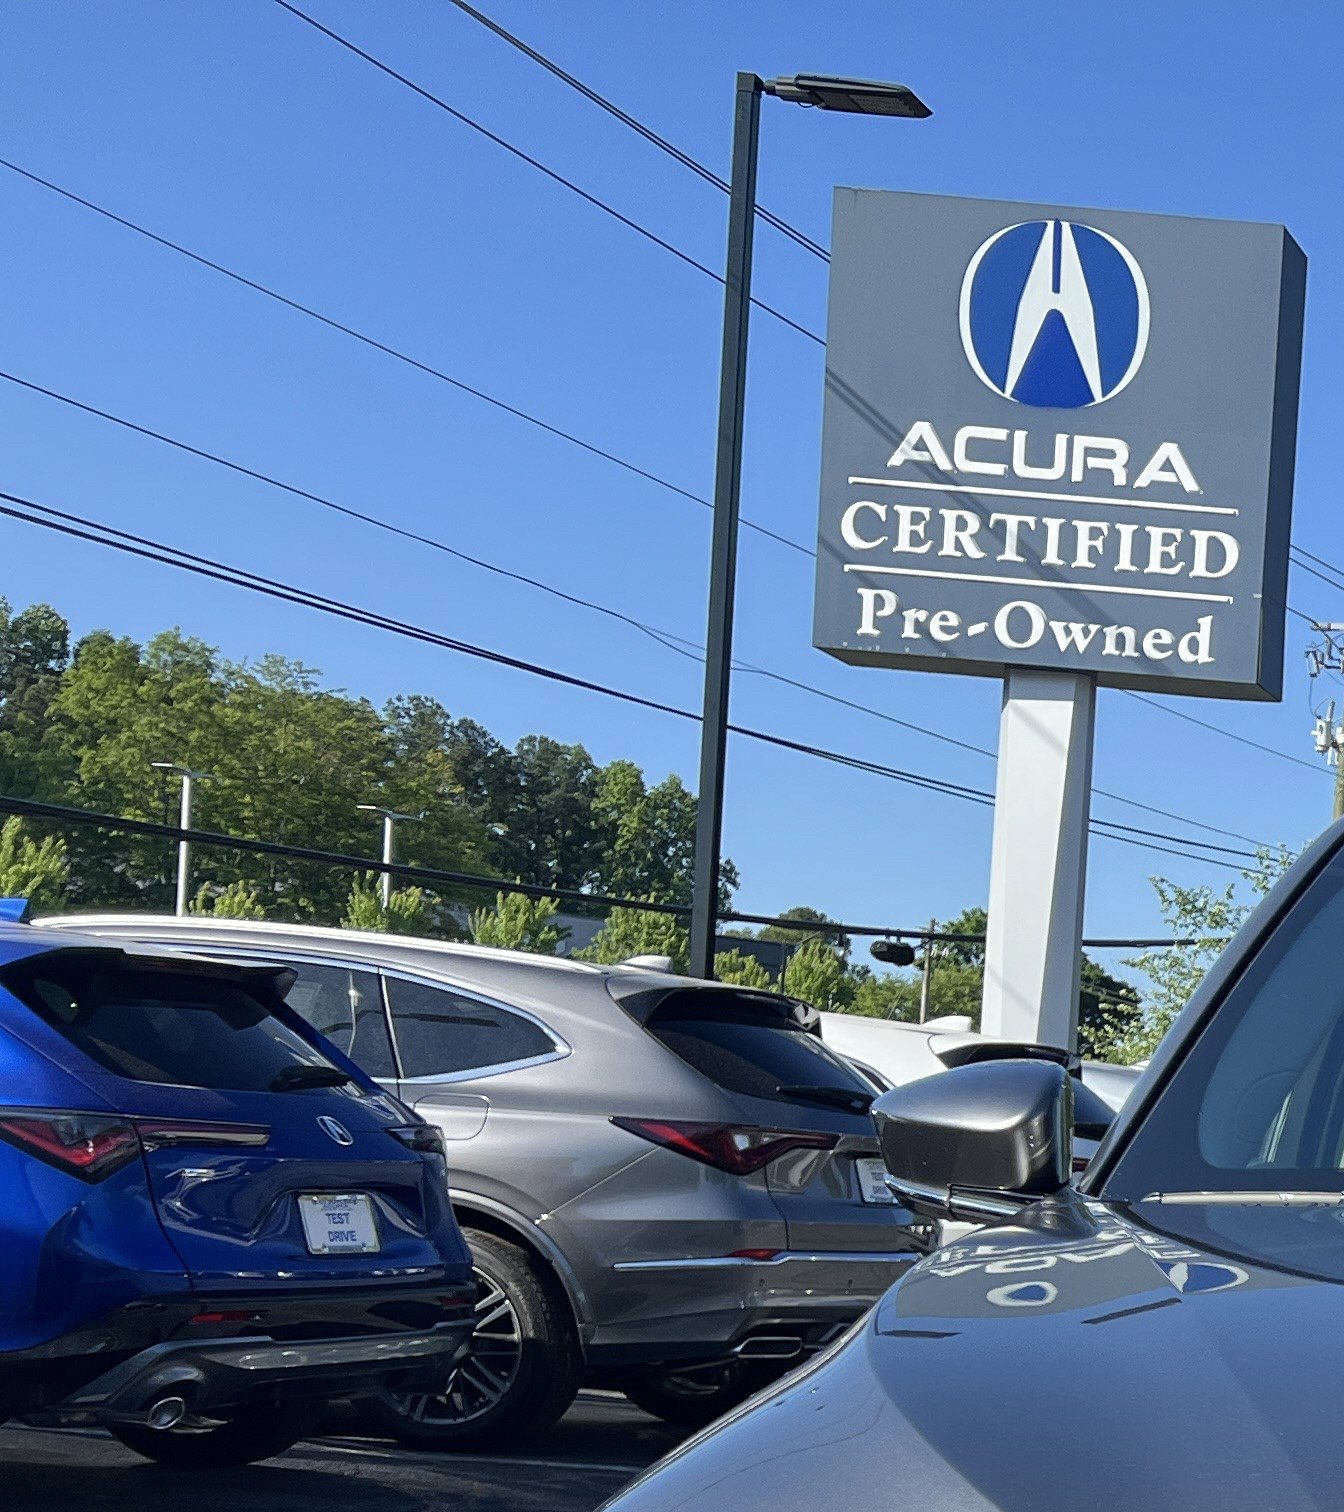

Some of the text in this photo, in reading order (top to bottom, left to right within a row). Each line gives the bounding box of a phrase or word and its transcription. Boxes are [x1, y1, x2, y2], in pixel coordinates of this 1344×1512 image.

[886, 420, 1204, 494] ACURA
[840, 500, 1240, 580] CERTIFIED
[855, 586, 1215, 664] Pre-Owned
[325, 1212, 350, 1225] TEST
[327, 1230, 357, 1242] DRIVE
